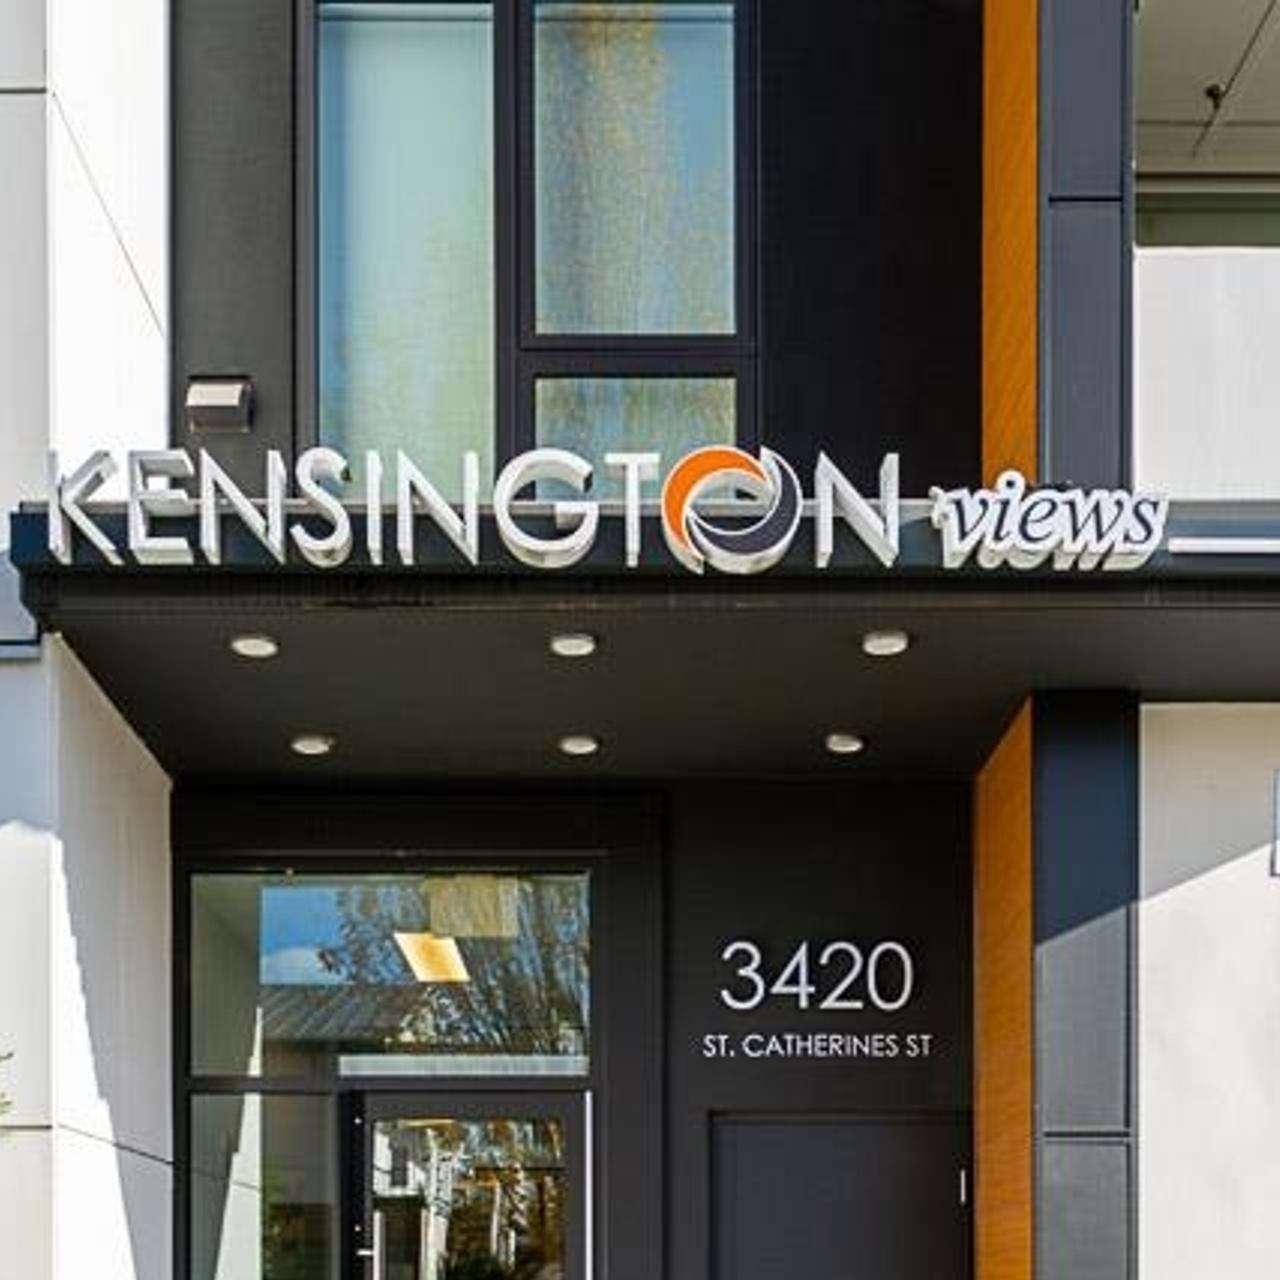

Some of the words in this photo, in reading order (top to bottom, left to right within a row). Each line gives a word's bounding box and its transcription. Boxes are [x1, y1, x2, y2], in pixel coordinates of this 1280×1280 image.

[48, 445, 900, 574] KENSINGTON
[936, 471, 1167, 562] views
[720, 940, 915, 1011] 3420
[702, 1034, 736, 1058] ST.
[741, 1034, 900, 1058] CATHERINES
[906, 1034, 934, 1058] ST
